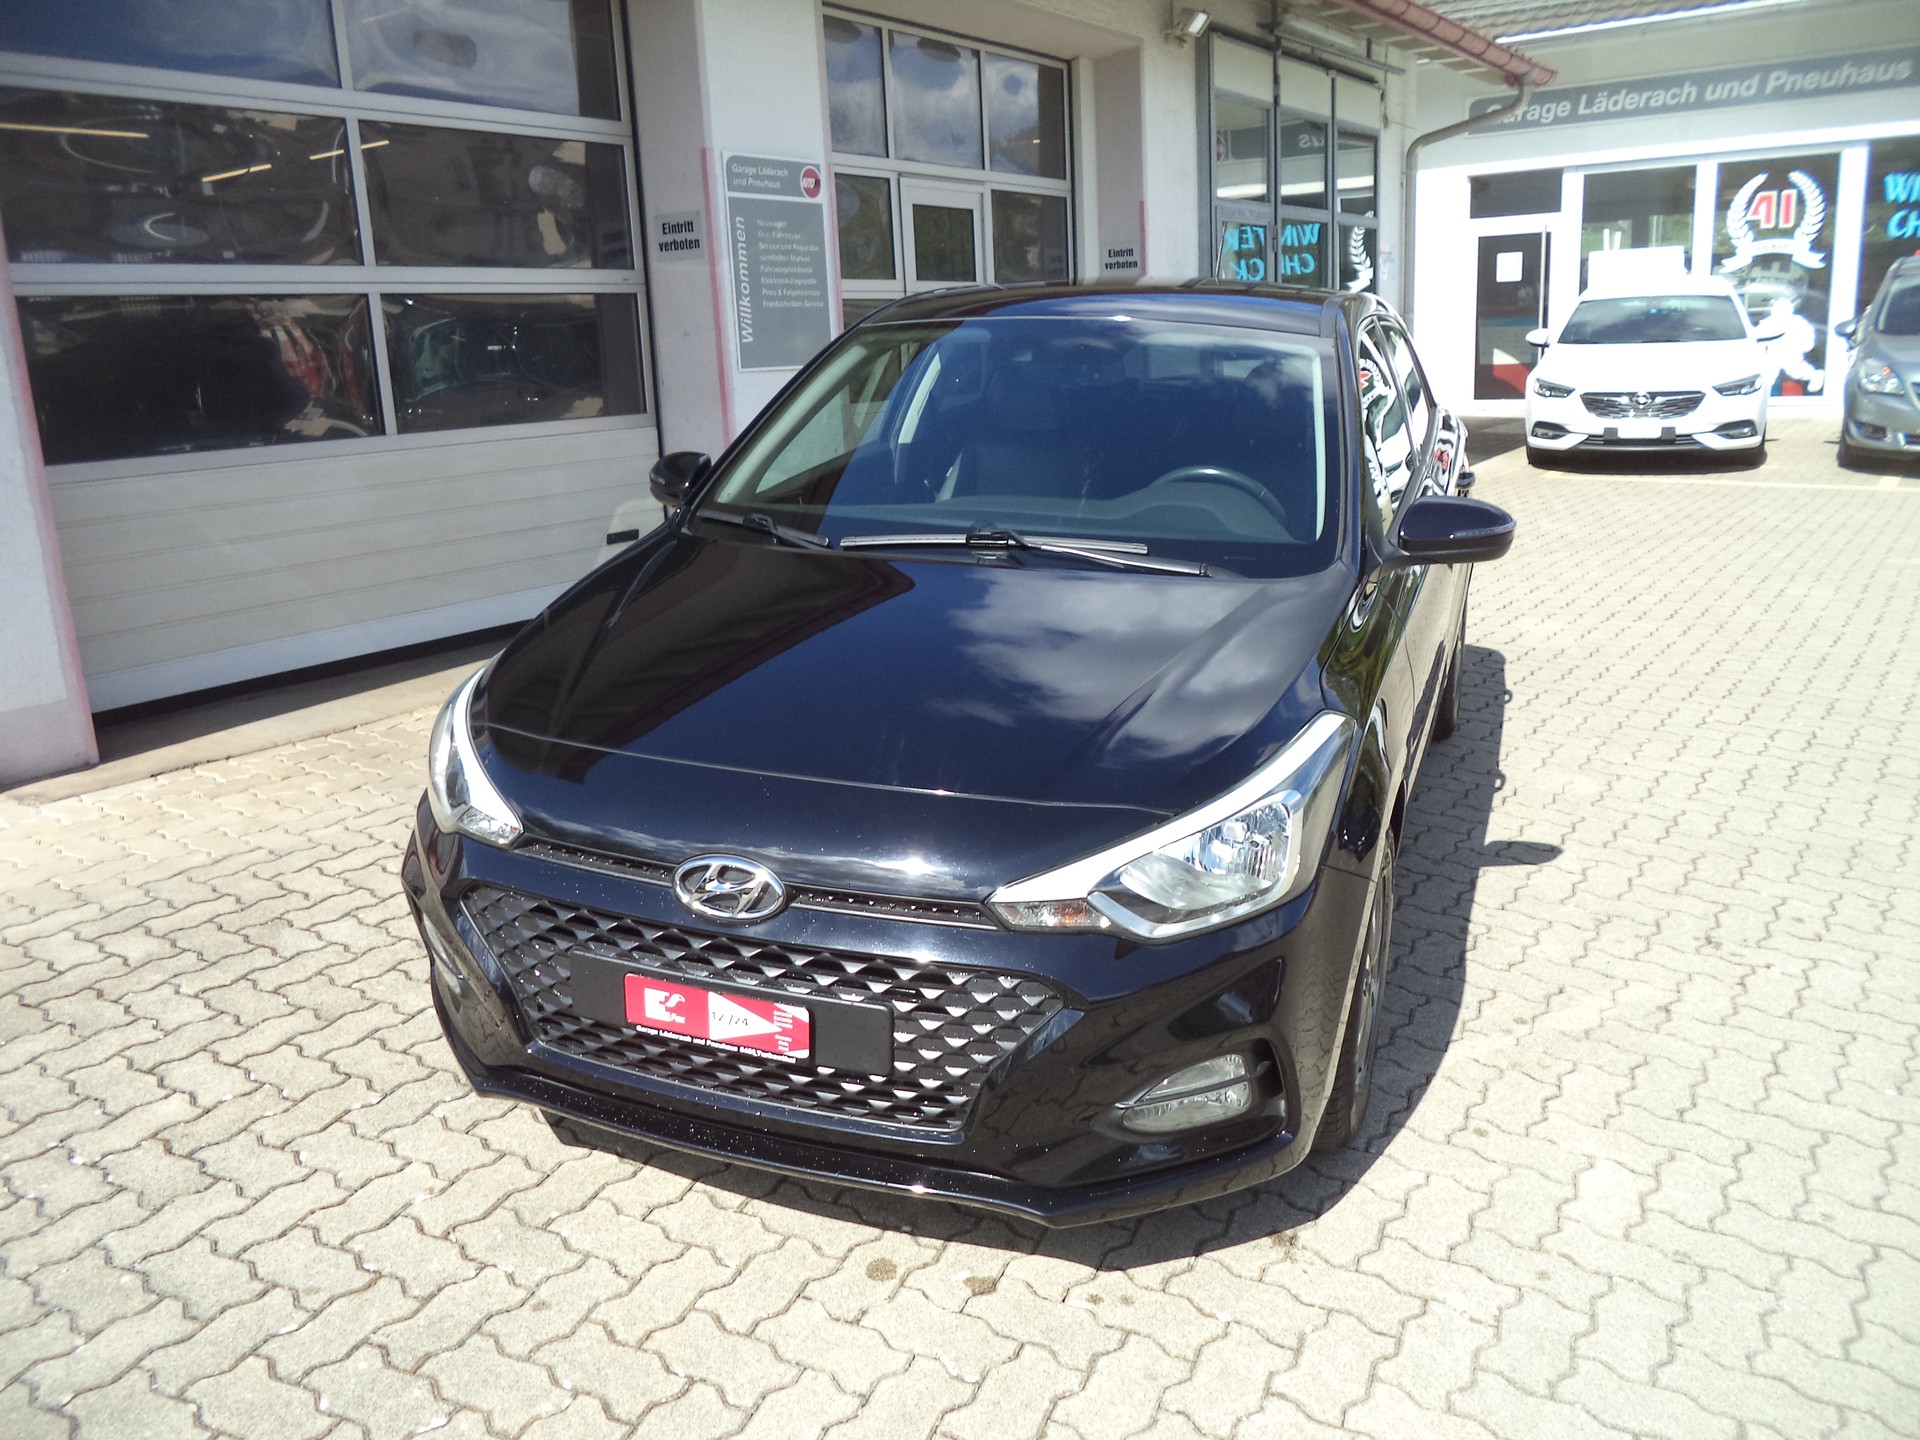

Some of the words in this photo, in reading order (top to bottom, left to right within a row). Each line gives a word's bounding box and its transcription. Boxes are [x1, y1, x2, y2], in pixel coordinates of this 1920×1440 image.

[1578, 81, 1696, 115] Läderach
[1705, 73, 1762, 101] und
[1766, 60, 1914, 95] Pneuhaus
[732, 163, 757, 175] Garage
[758, 165, 789, 177] Läderach
[733, 177, 747, 185] und
[747, 178, 781, 189] Pneuhaus
[661, 220, 695, 236] Eintritt
[658, 237, 701, 252] verboten
[1108, 248, 1135, 259] Eintritt
[1104, 260, 1139, 271] verboten
[735, 216, 754, 344] Willkommen
[635, 1024, 659, 1036] Garage
[659, 1029, 692, 1043] Läderach
[692, 1038, 706, 1046] und
[706, 1039, 739, 1052] Pneuhaus
